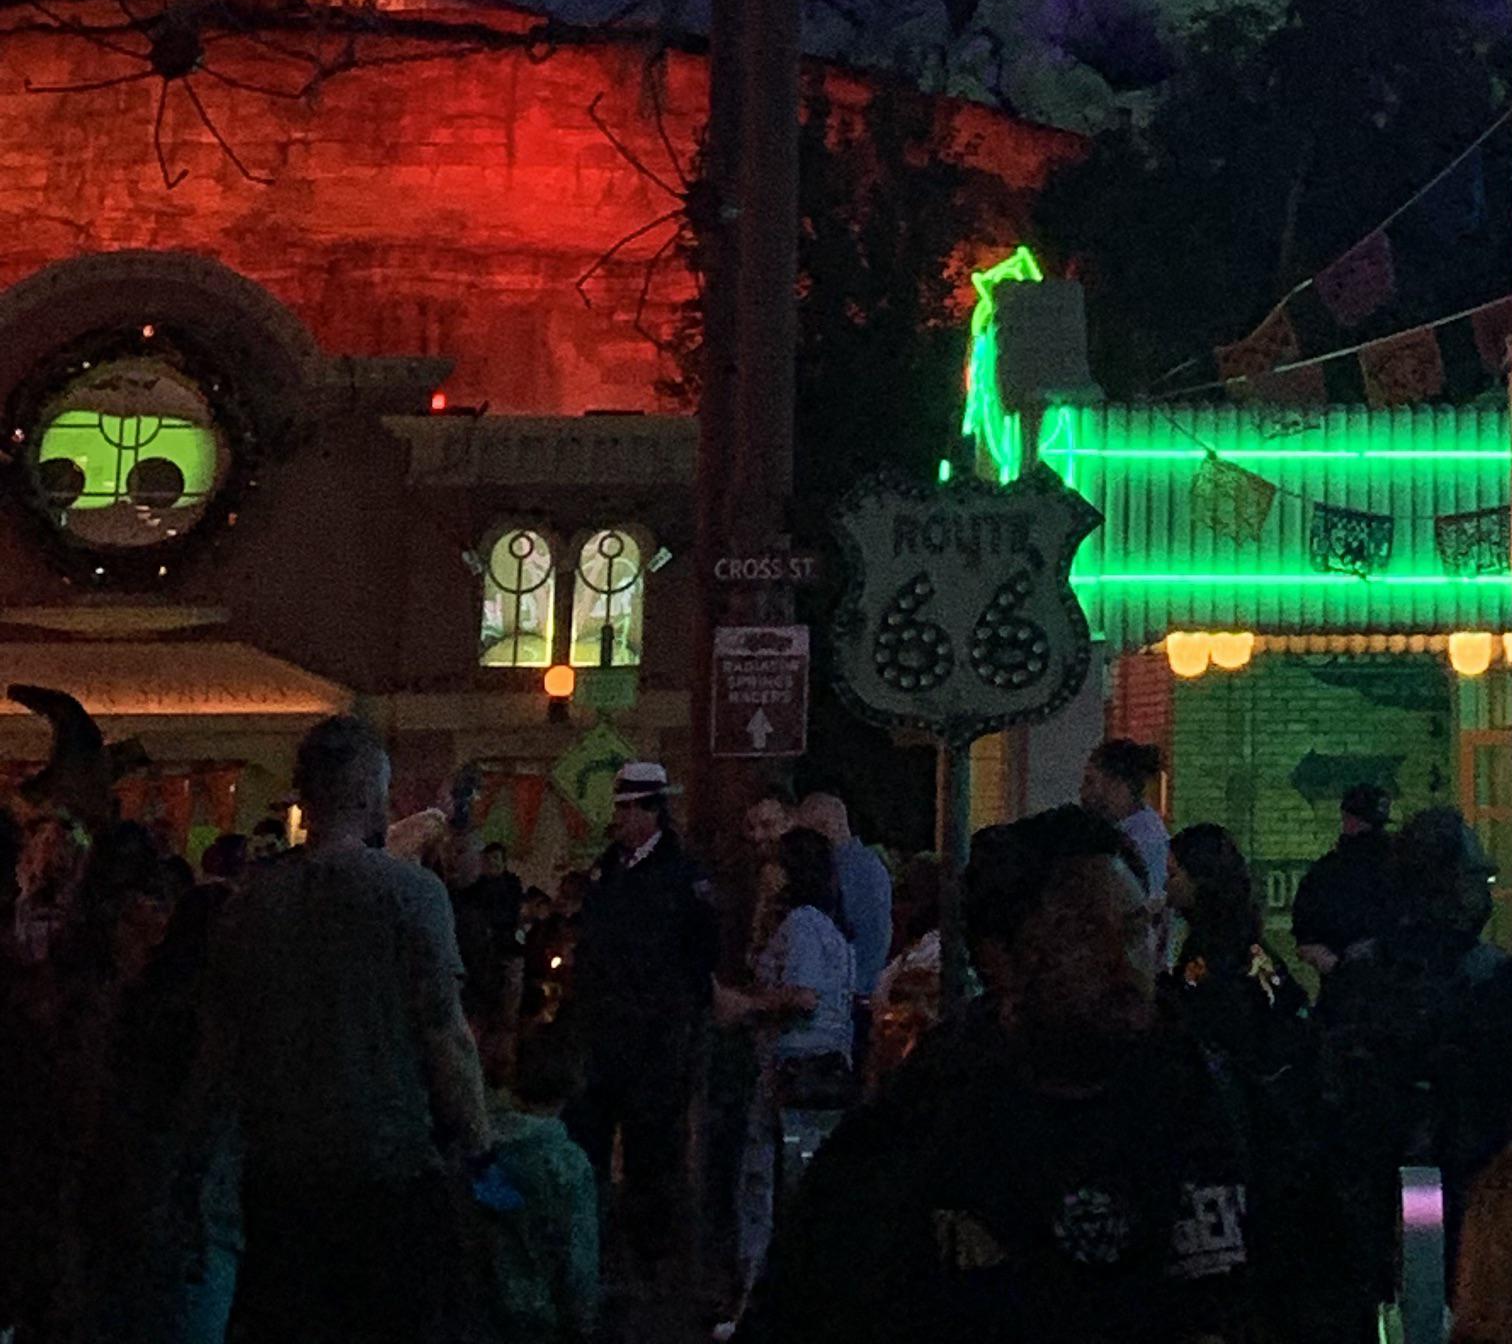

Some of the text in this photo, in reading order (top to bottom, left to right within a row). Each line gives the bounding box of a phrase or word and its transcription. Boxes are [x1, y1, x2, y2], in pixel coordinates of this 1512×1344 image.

[892, 511, 1040, 555] ROUTE
[713, 557, 784, 581] CROSS
[873, 569, 1052, 693] 66
